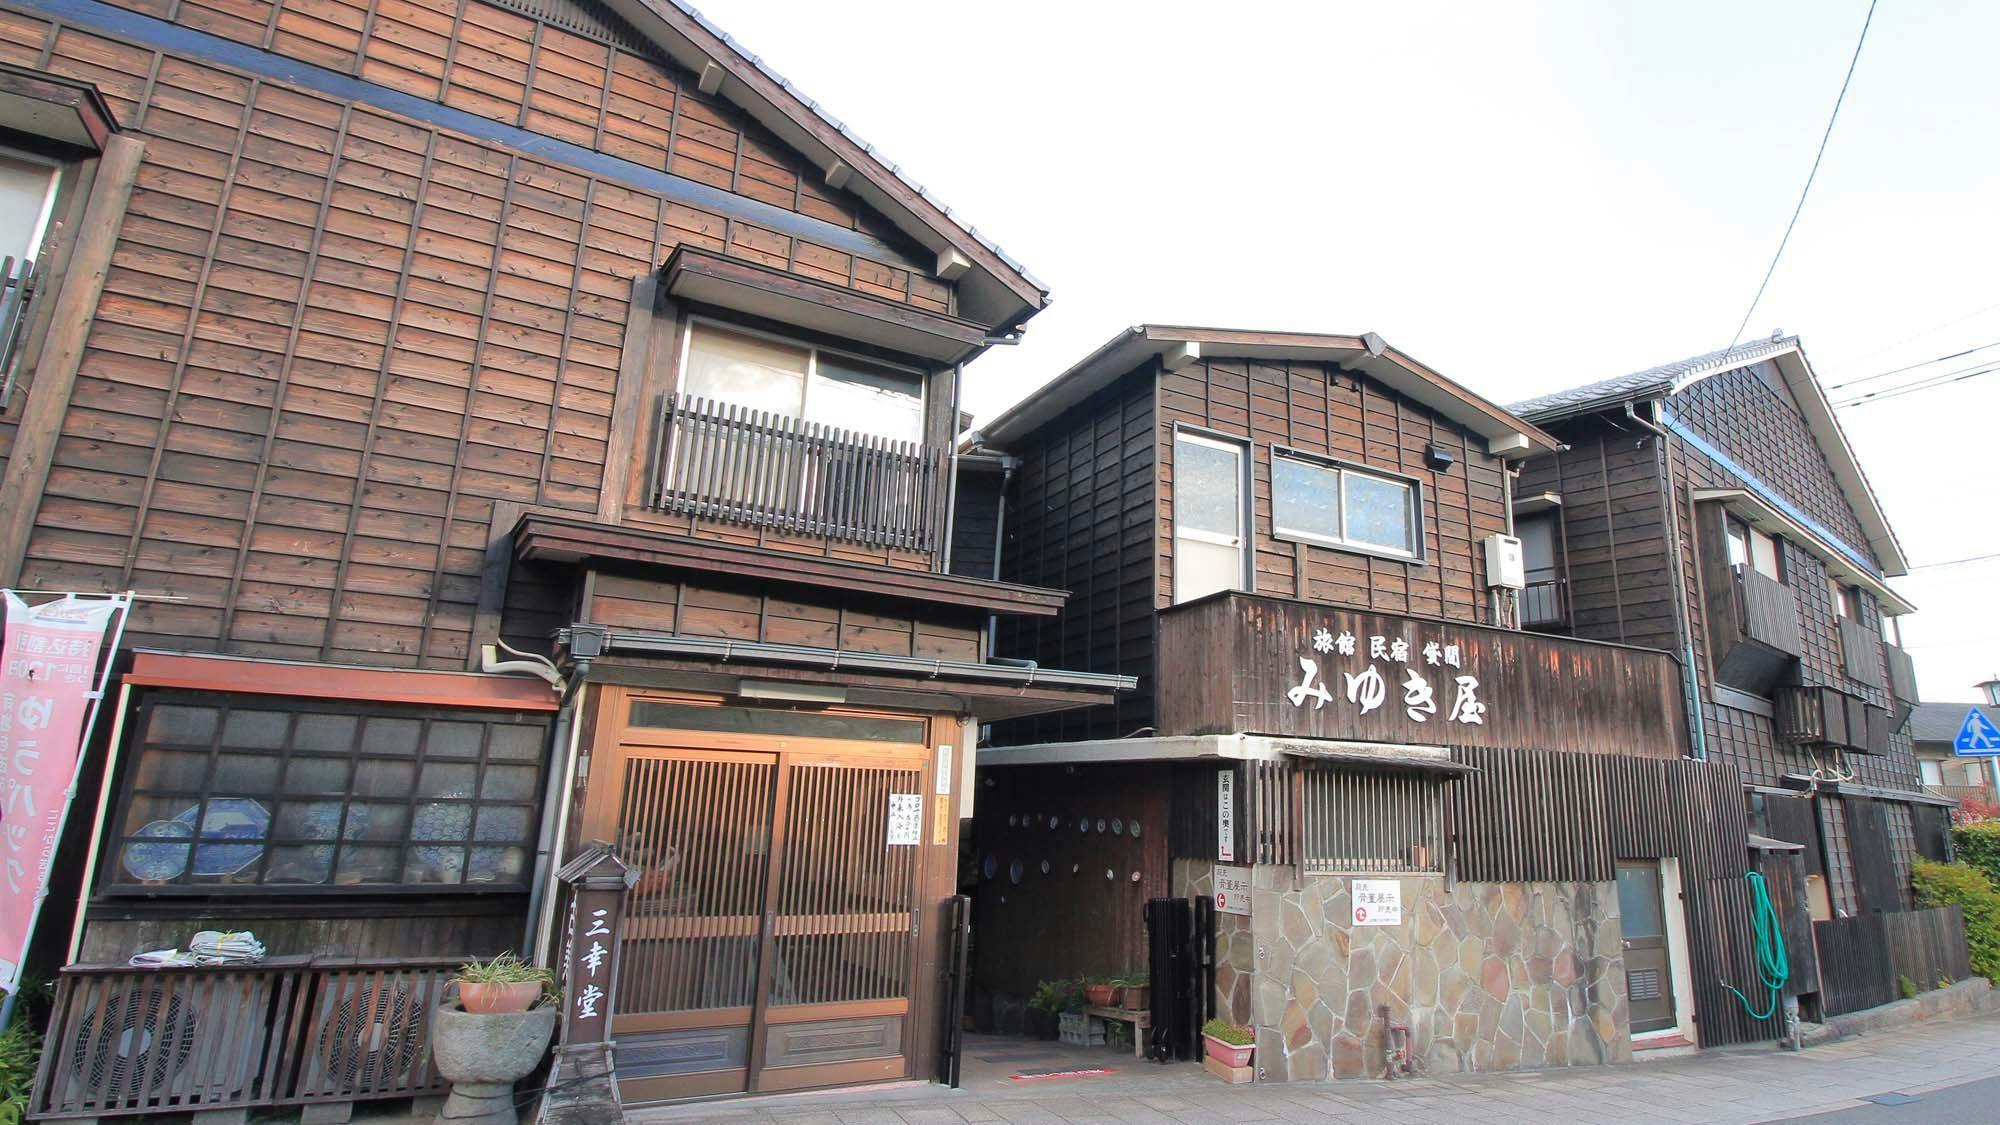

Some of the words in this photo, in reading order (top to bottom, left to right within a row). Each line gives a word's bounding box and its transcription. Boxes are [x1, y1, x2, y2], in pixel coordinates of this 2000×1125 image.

[1313, 628, 1356, 656] 旅館
[1369, 635, 1410, 663] 民宿
[1422, 640, 1461, 669] 貸間
[1287, 655, 1486, 725] みゆき屋
[1218, 878, 1248, 892] 骨董展示
[1358, 892, 1395, 903] 骨董展示
[577, 909, 610, 1019] 三幸堂
